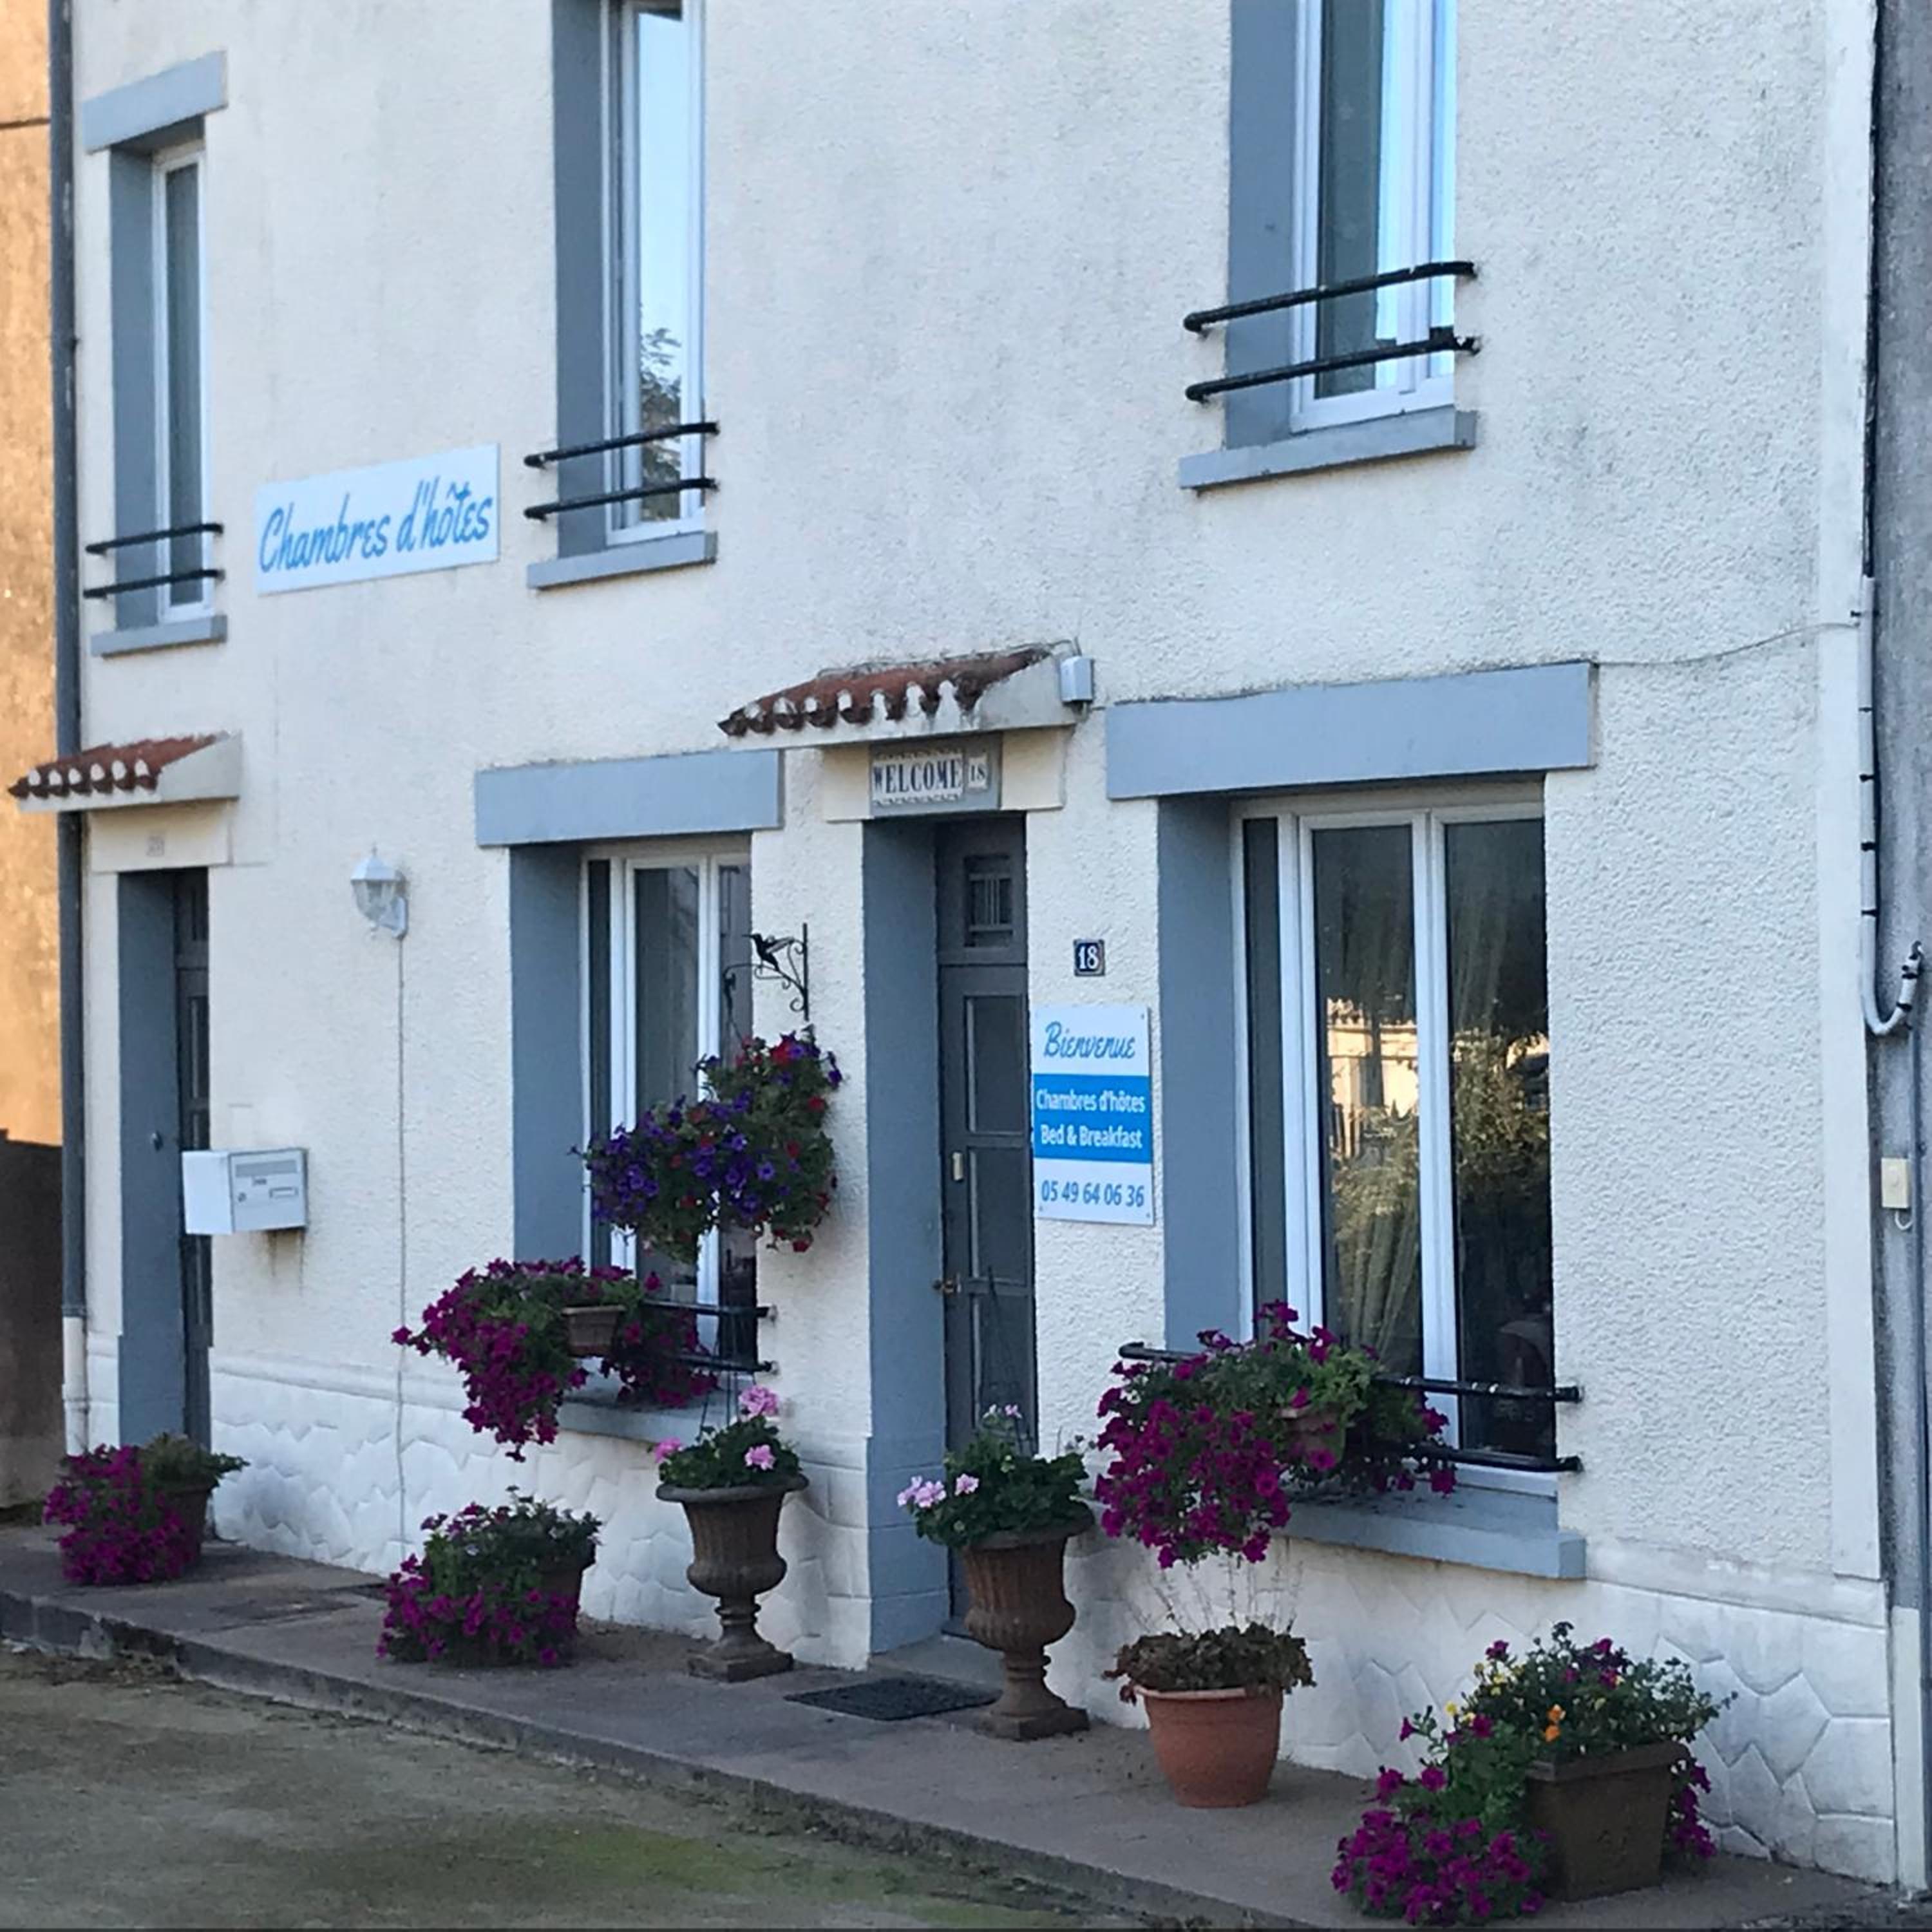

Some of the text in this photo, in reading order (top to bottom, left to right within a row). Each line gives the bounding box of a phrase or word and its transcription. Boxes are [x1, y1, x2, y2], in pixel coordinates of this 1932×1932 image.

[260, 476, 493, 573] Chambres d'hôtes
[873, 759, 963, 793] WELCOME
[1078, 945, 1099, 969] 18
[1043, 1021, 1136, 1059] Bienvenue
[1036, 1088, 1146, 1113] Chambres d'hôtes
[1040, 1124, 1143, 1150] Bed & Breakfast
[1041, 1180, 1145, 1208] 05 49 64 06 36
